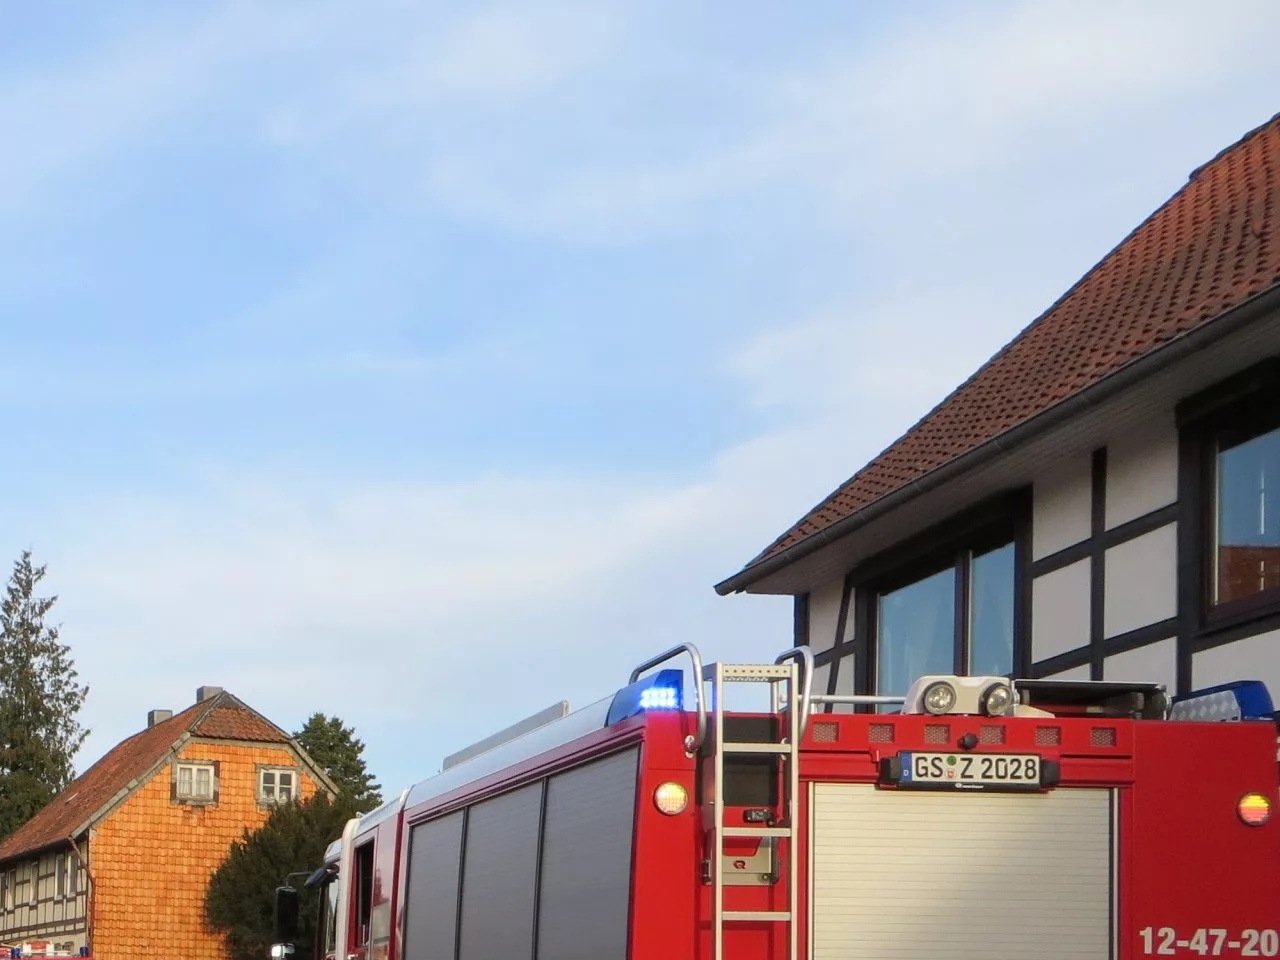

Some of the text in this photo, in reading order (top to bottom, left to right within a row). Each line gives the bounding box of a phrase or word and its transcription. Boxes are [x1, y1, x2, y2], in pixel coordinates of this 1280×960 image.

[915, 756, 1037, 780] GS Z 2028
[1139, 926, 1279, 957] 12-47-20
